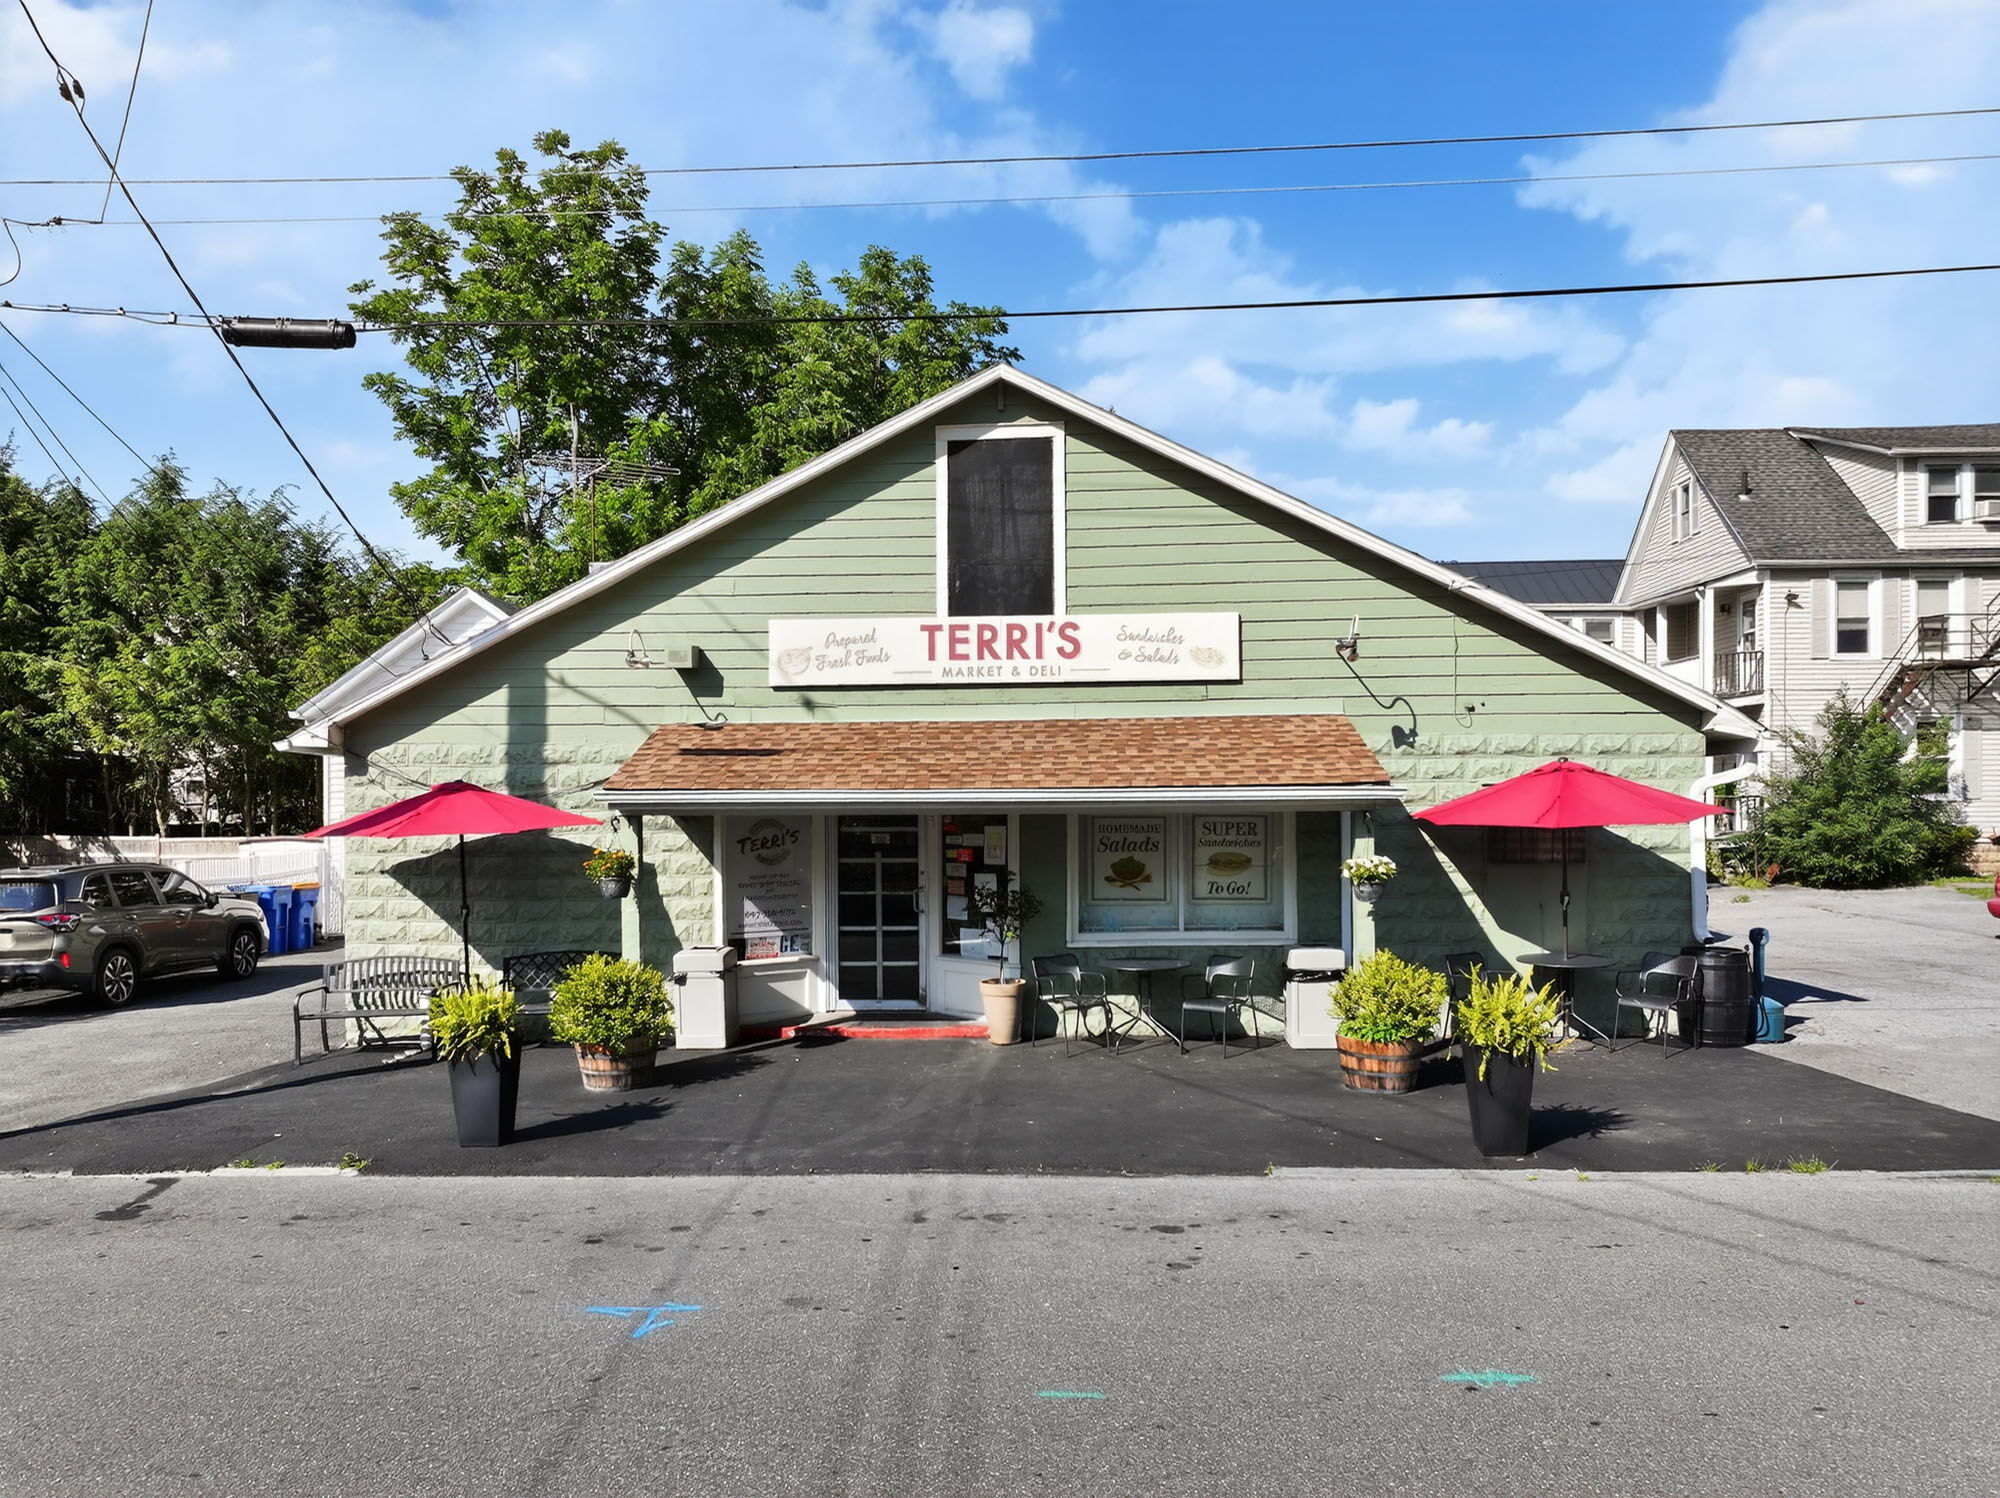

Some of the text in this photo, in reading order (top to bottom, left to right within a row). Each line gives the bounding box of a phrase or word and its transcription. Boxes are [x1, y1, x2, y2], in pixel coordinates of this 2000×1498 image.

[824, 627, 877, 649] Prepared
[919, 621, 1081, 661] TERRI'S
[1116, 624, 1185, 645] Sandwiches
[815, 649, 852, 671] Fresh
[1134, 646, 1180, 664] Salads
[941, 665, 1061, 678] MARKET & DELI
[1098, 823, 1161, 834] HOMEMADE
[1202, 821, 1258, 836] SUPER
[736, 828, 800, 855] TERRI'S
[1097, 835, 1160, 853] Salads
[1208, 880, 1251, 895] To Go!
